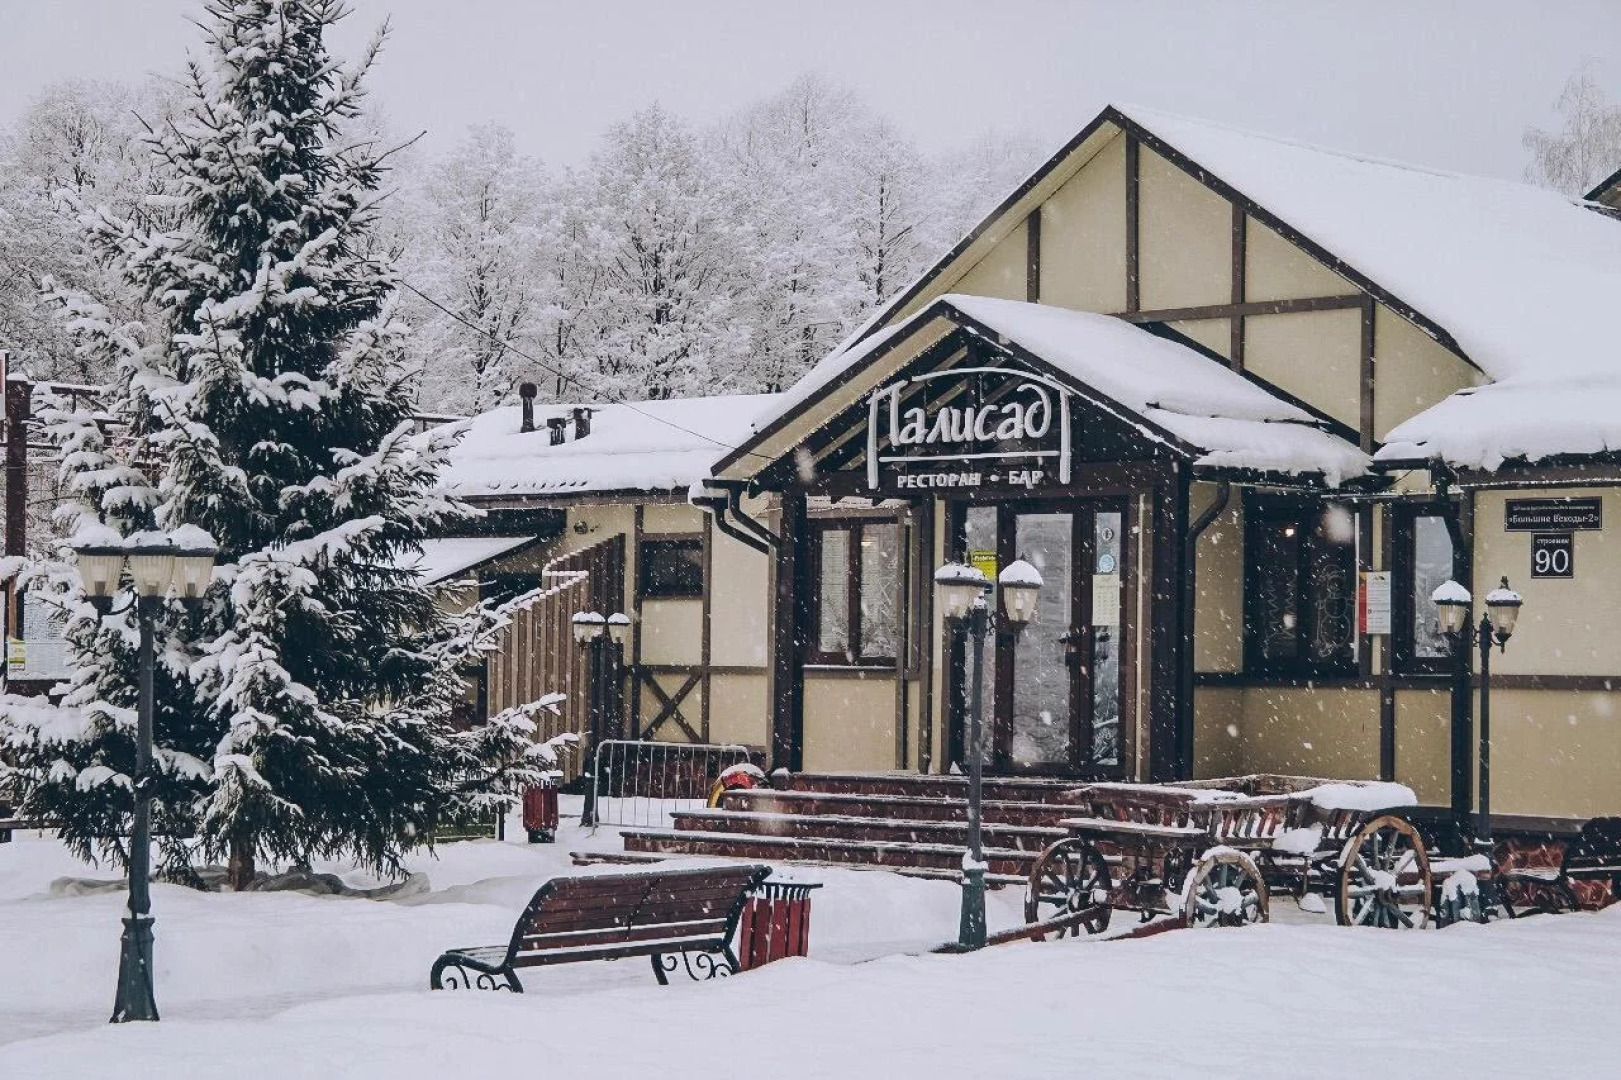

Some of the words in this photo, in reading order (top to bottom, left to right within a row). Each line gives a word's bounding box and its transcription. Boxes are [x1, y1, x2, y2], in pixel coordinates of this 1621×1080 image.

[867, 380, 1052, 489] Палисад
[897, 472, 982, 489] РЕСТОРАН
[1008, 470, 1044, 489] БАР
[1535, 548, 1569, 573] 90
